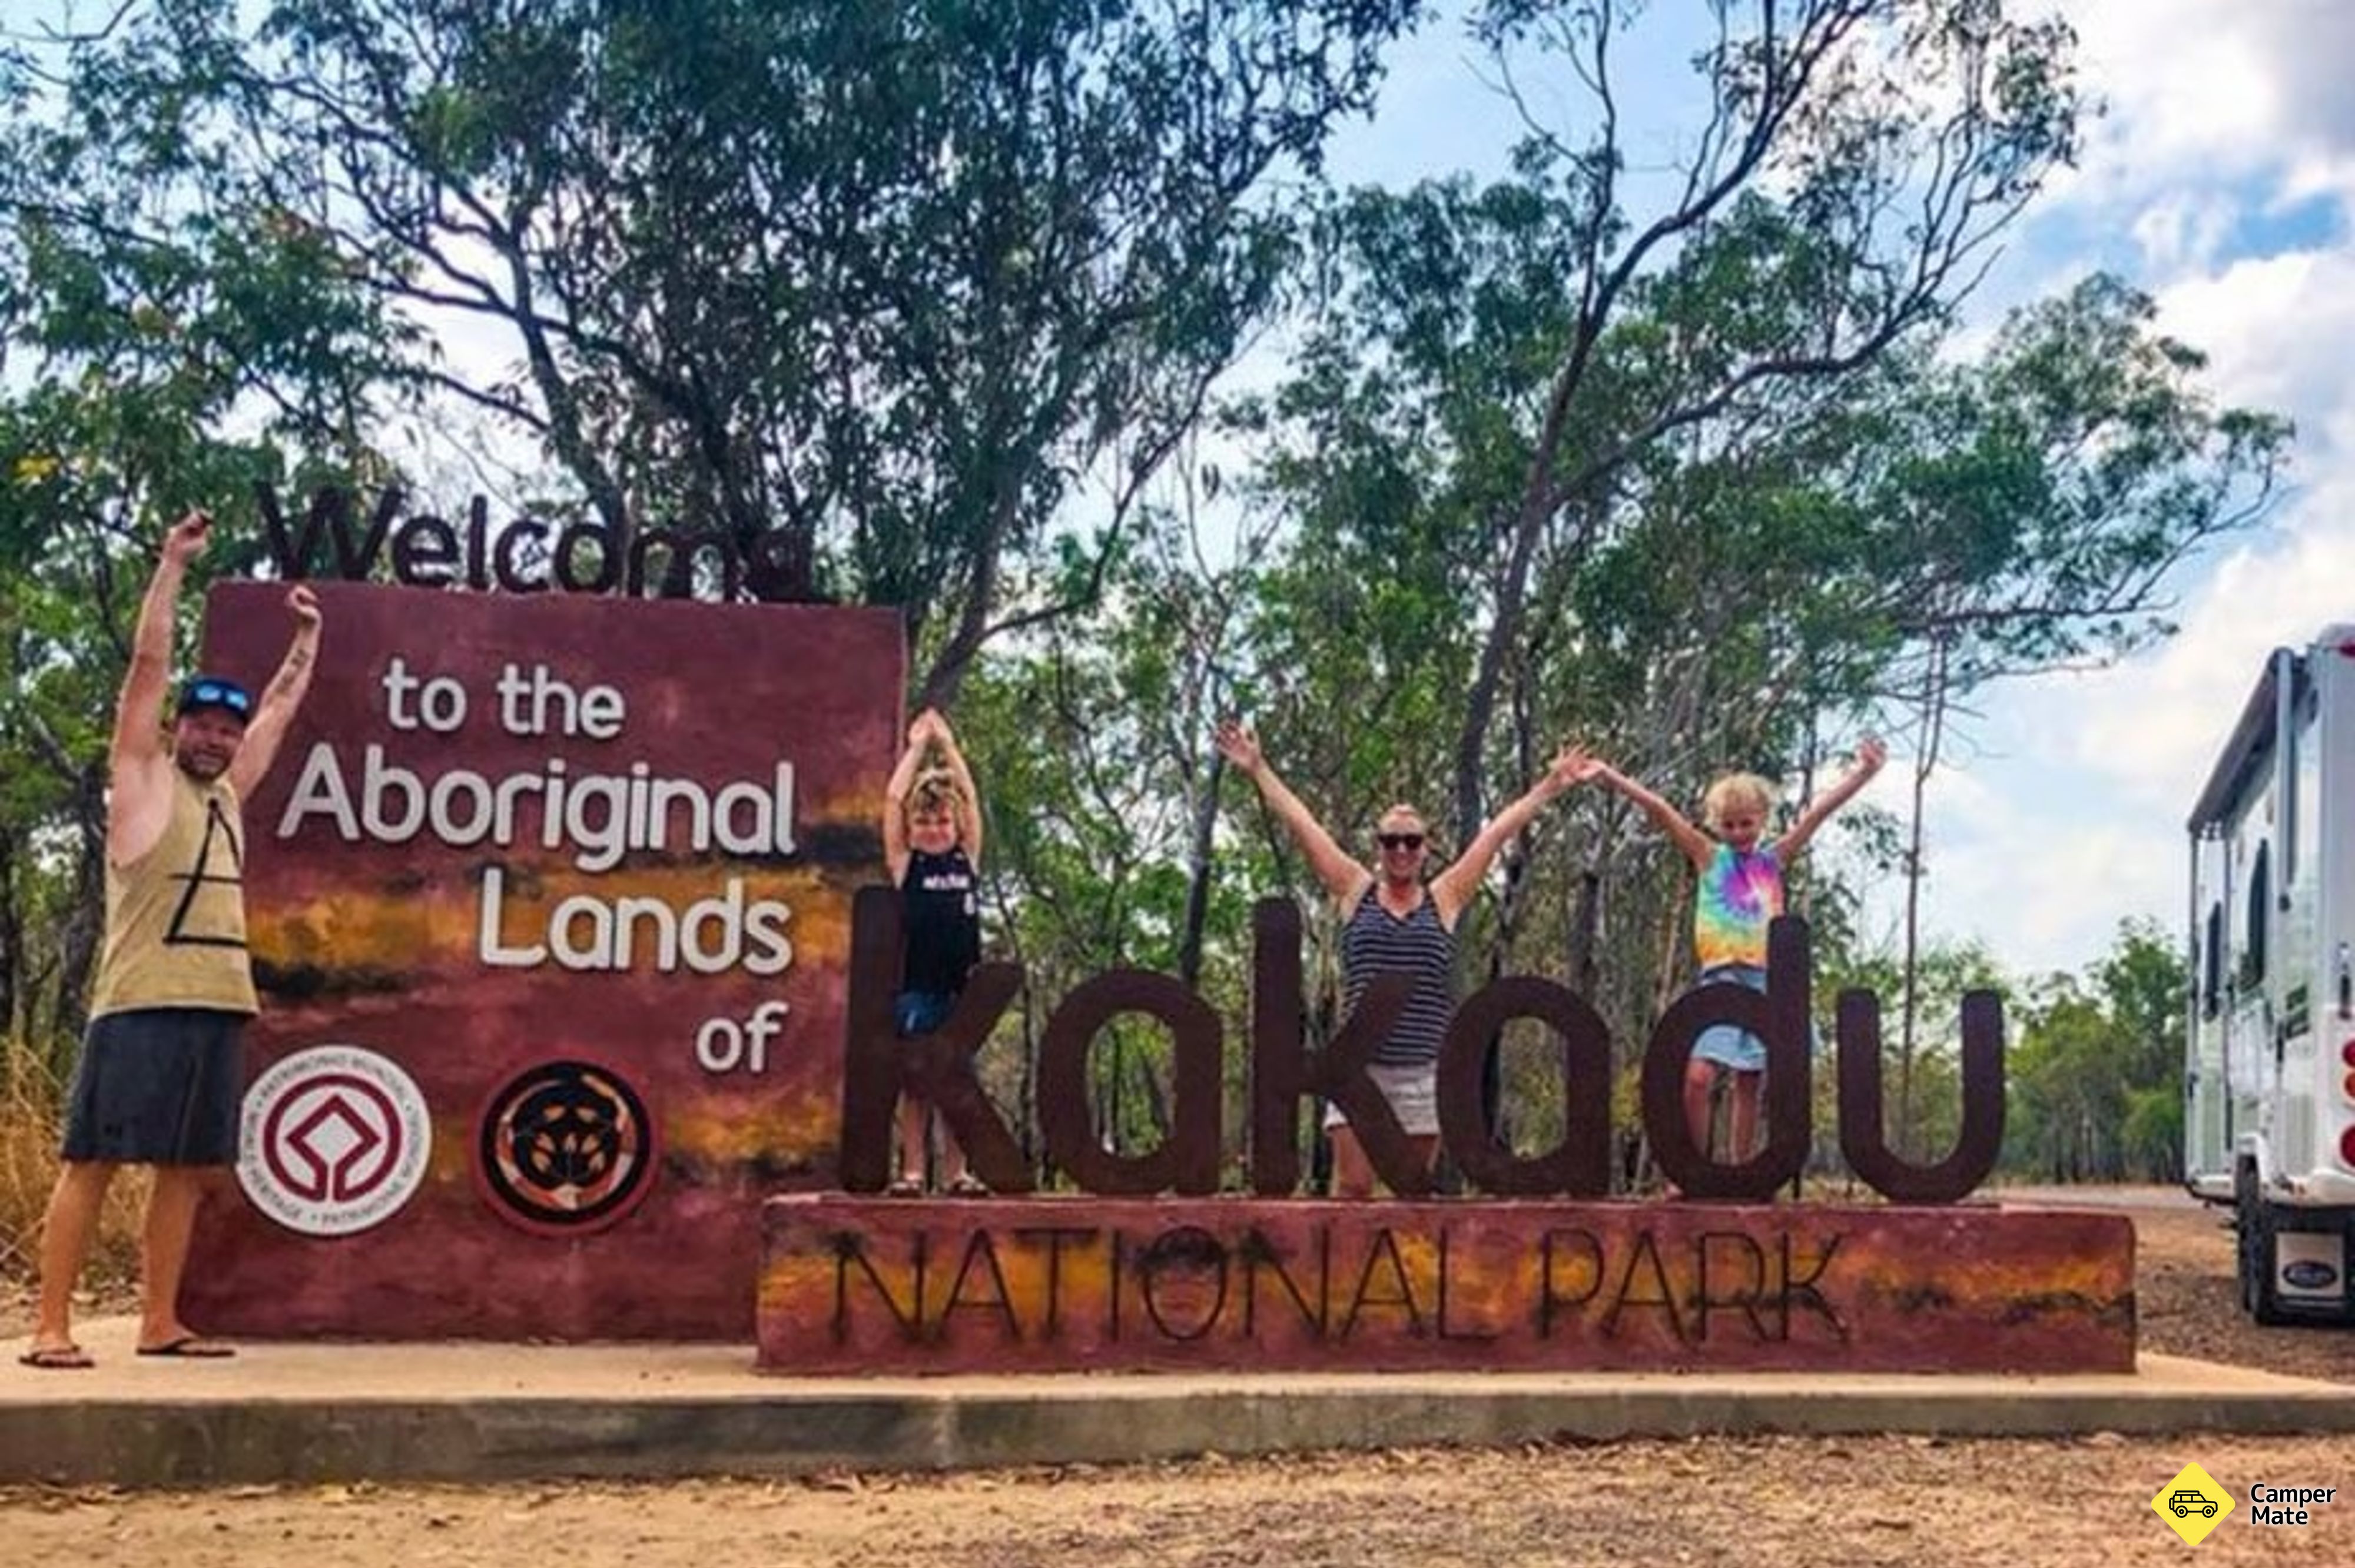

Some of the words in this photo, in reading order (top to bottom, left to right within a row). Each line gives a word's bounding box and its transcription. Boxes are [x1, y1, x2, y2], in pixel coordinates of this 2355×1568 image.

[254, 480, 815, 604] Welcome
[383, 657, 466, 732] to
[496, 664, 625, 738] the
[278, 743, 796, 872] Aboriginal
[480, 868, 792, 975] Lands
[696, 1001, 789, 1072] of
[832, 1226, 1491, 1345] NATIONAL
[1538, 1230, 1847, 1347] PARK
